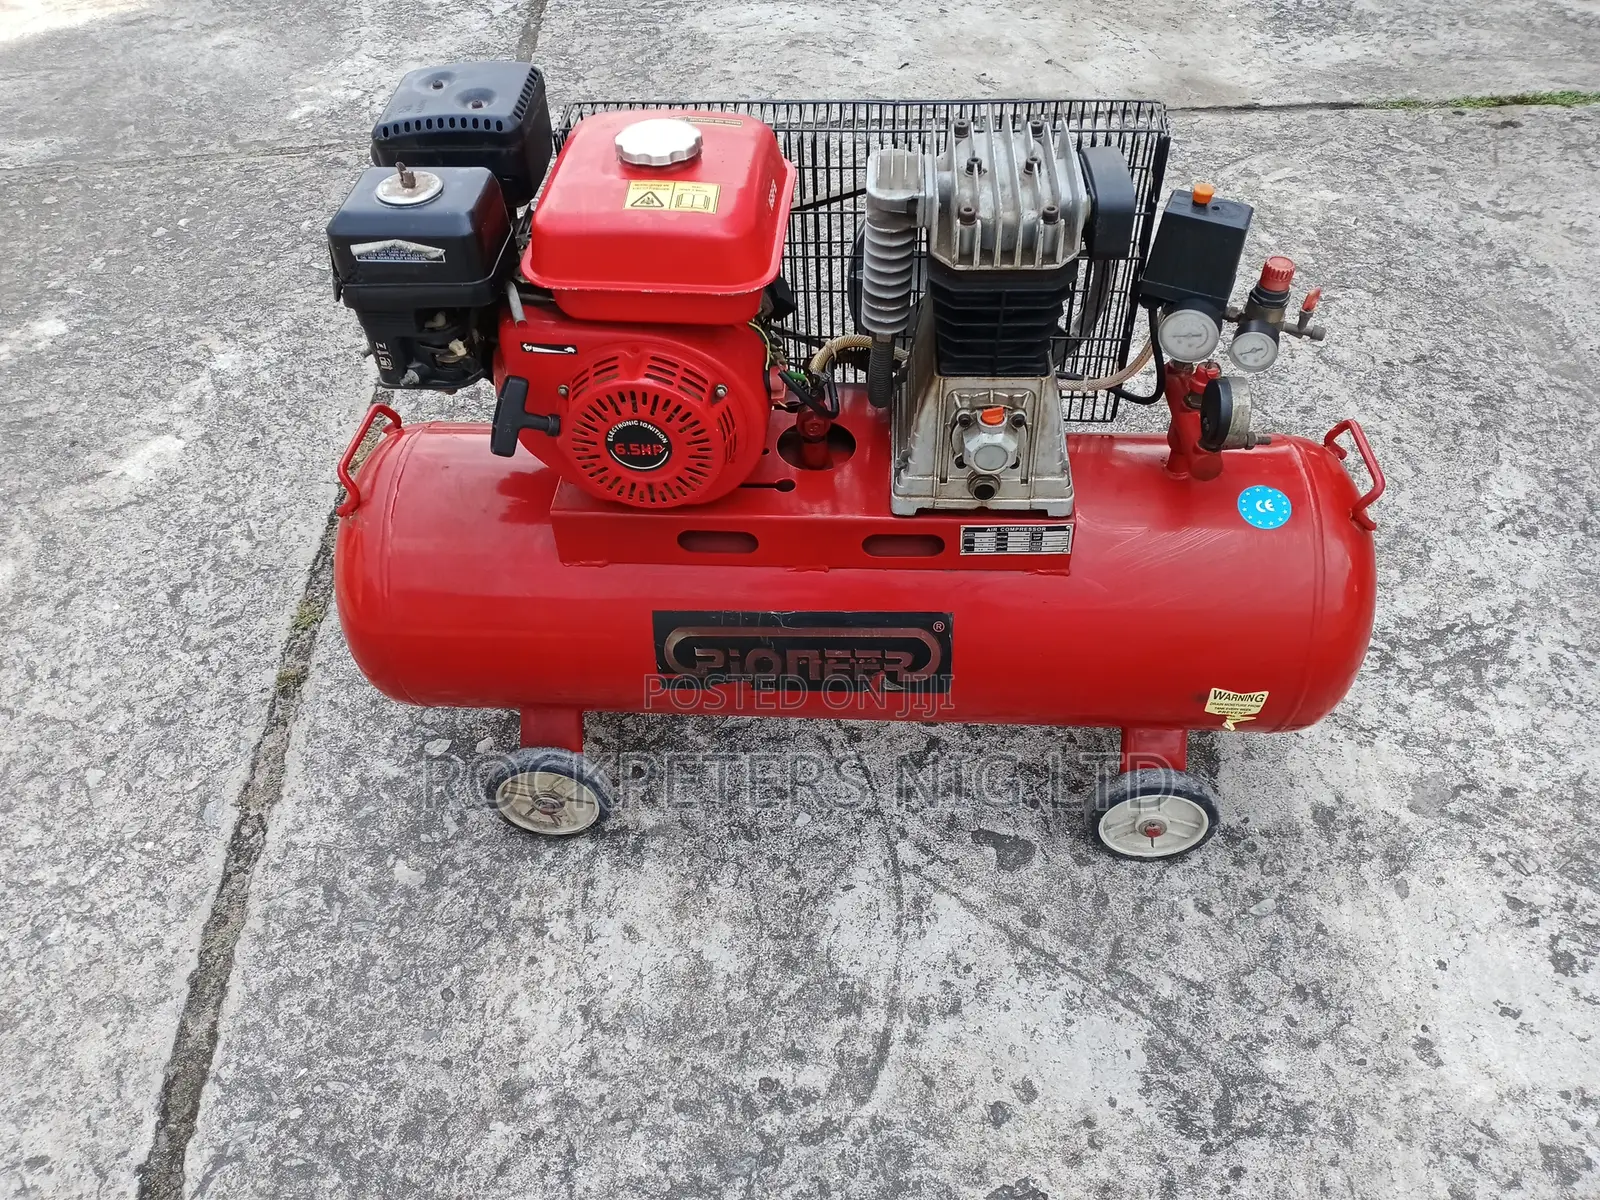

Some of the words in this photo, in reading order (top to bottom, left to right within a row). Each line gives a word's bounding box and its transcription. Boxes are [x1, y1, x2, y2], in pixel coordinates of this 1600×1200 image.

[607, 420, 639, 442] ELECTRONIC
[640, 421, 668, 444] IGNITION
[614, 443, 665, 456] 6.5HP
[1213, 690, 1265, 703] WARNING
